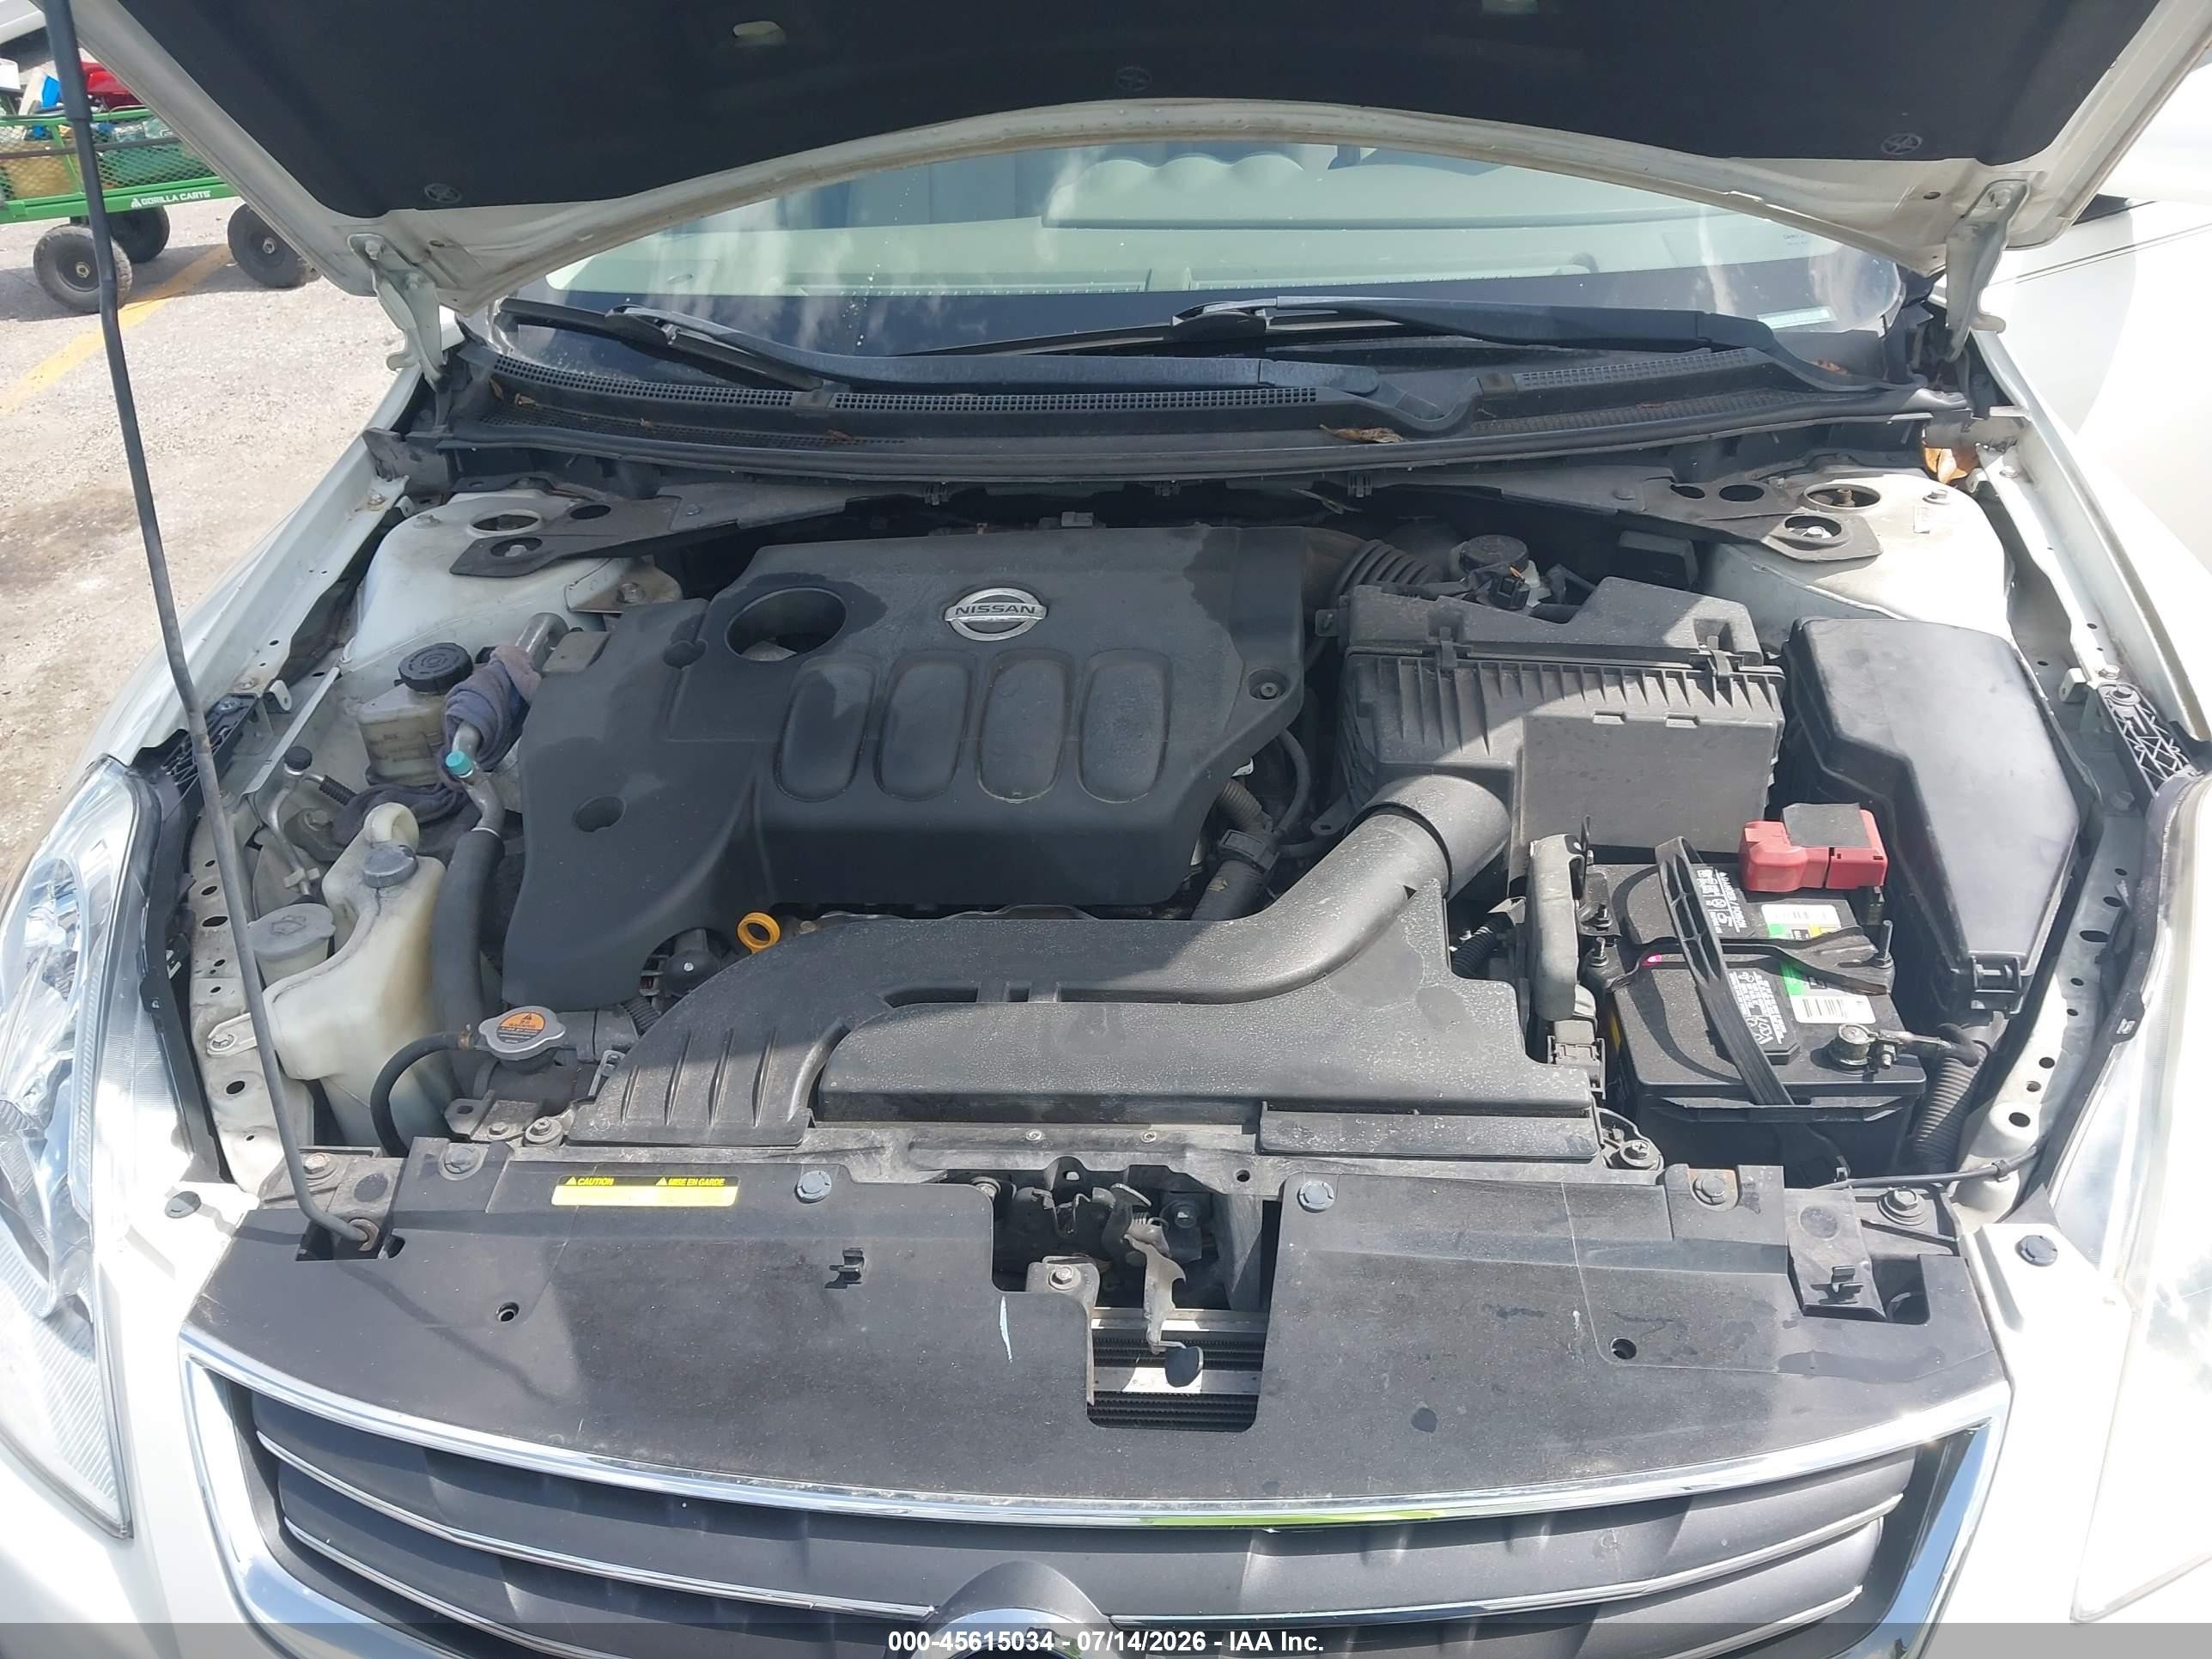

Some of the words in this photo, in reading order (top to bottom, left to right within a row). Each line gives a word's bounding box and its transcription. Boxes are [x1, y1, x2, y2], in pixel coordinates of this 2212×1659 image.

[141, 196, 179, 205] GORILLA
[179, 191, 211, 200] CARTS
[955, 605, 1036, 615] NISSAN
[1722, 878, 1737, 901] DANGER
[577, 1177, 614, 1186] CAUTION
